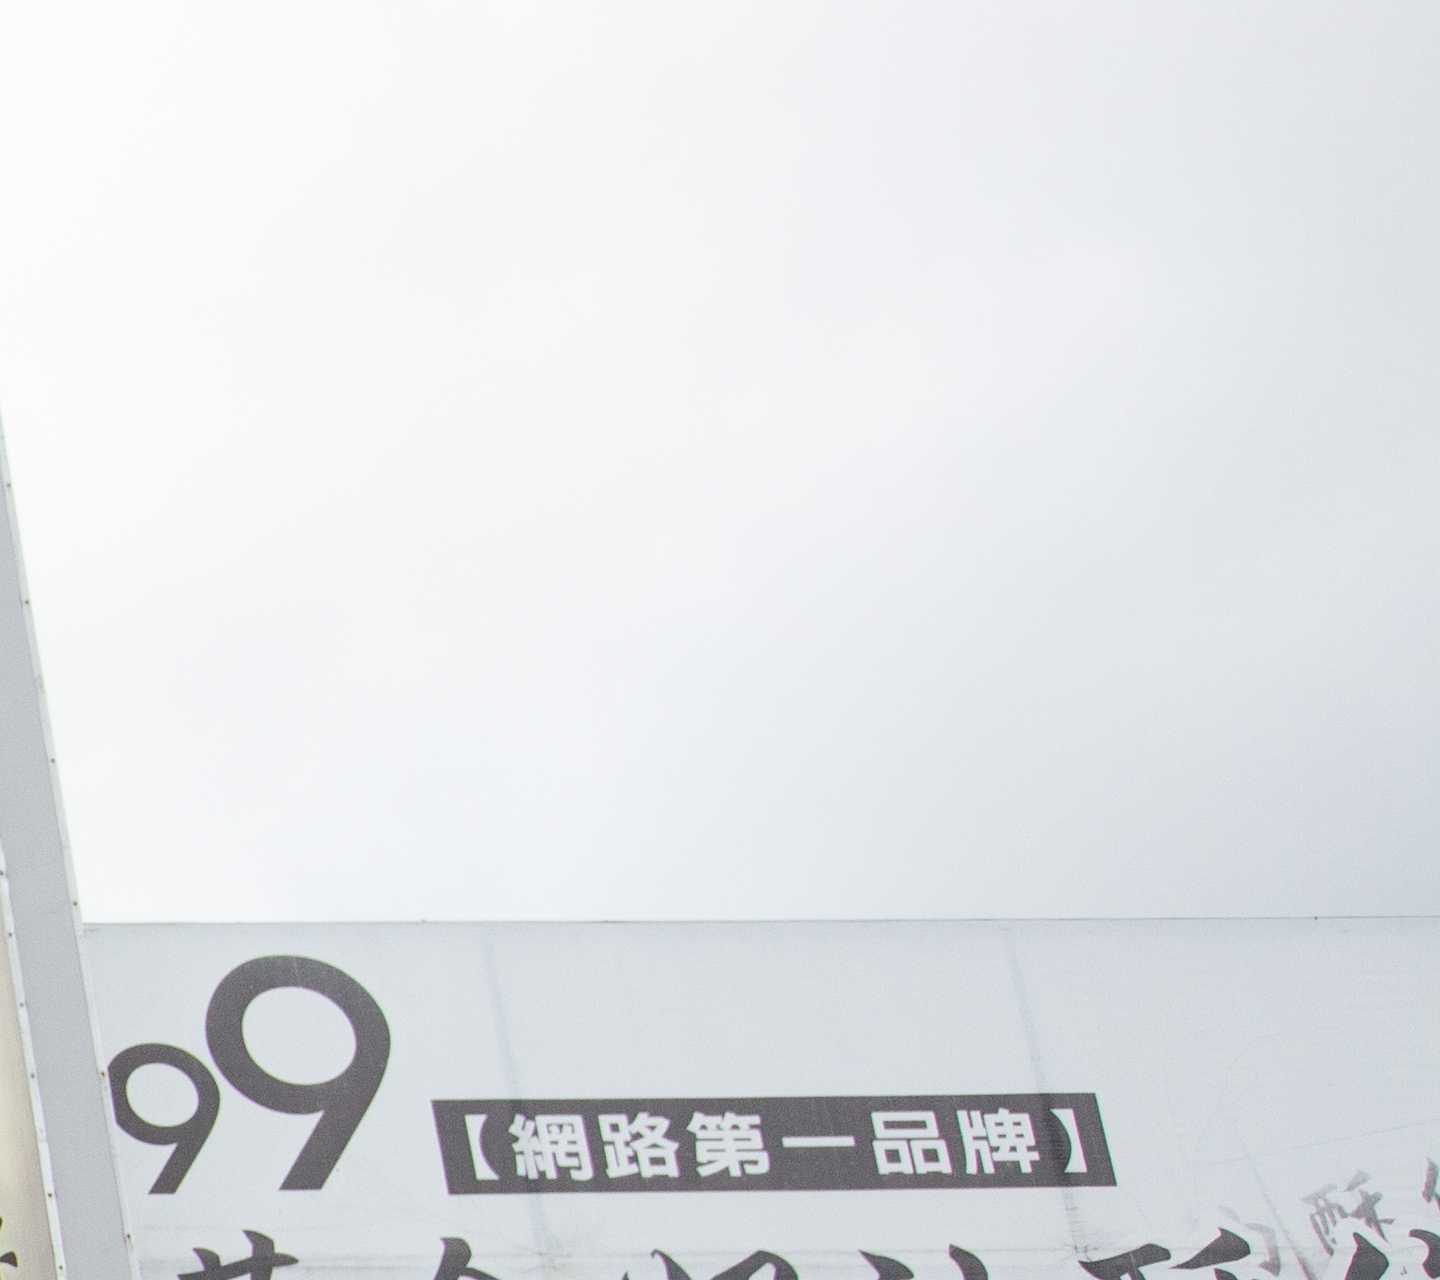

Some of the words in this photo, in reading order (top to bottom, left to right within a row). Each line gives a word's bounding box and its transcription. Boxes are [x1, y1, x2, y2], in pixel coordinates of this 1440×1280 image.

[107, 955, 391, 1194] 99
[465, 1108, 1088, 1181] 【網路第一品牌】
